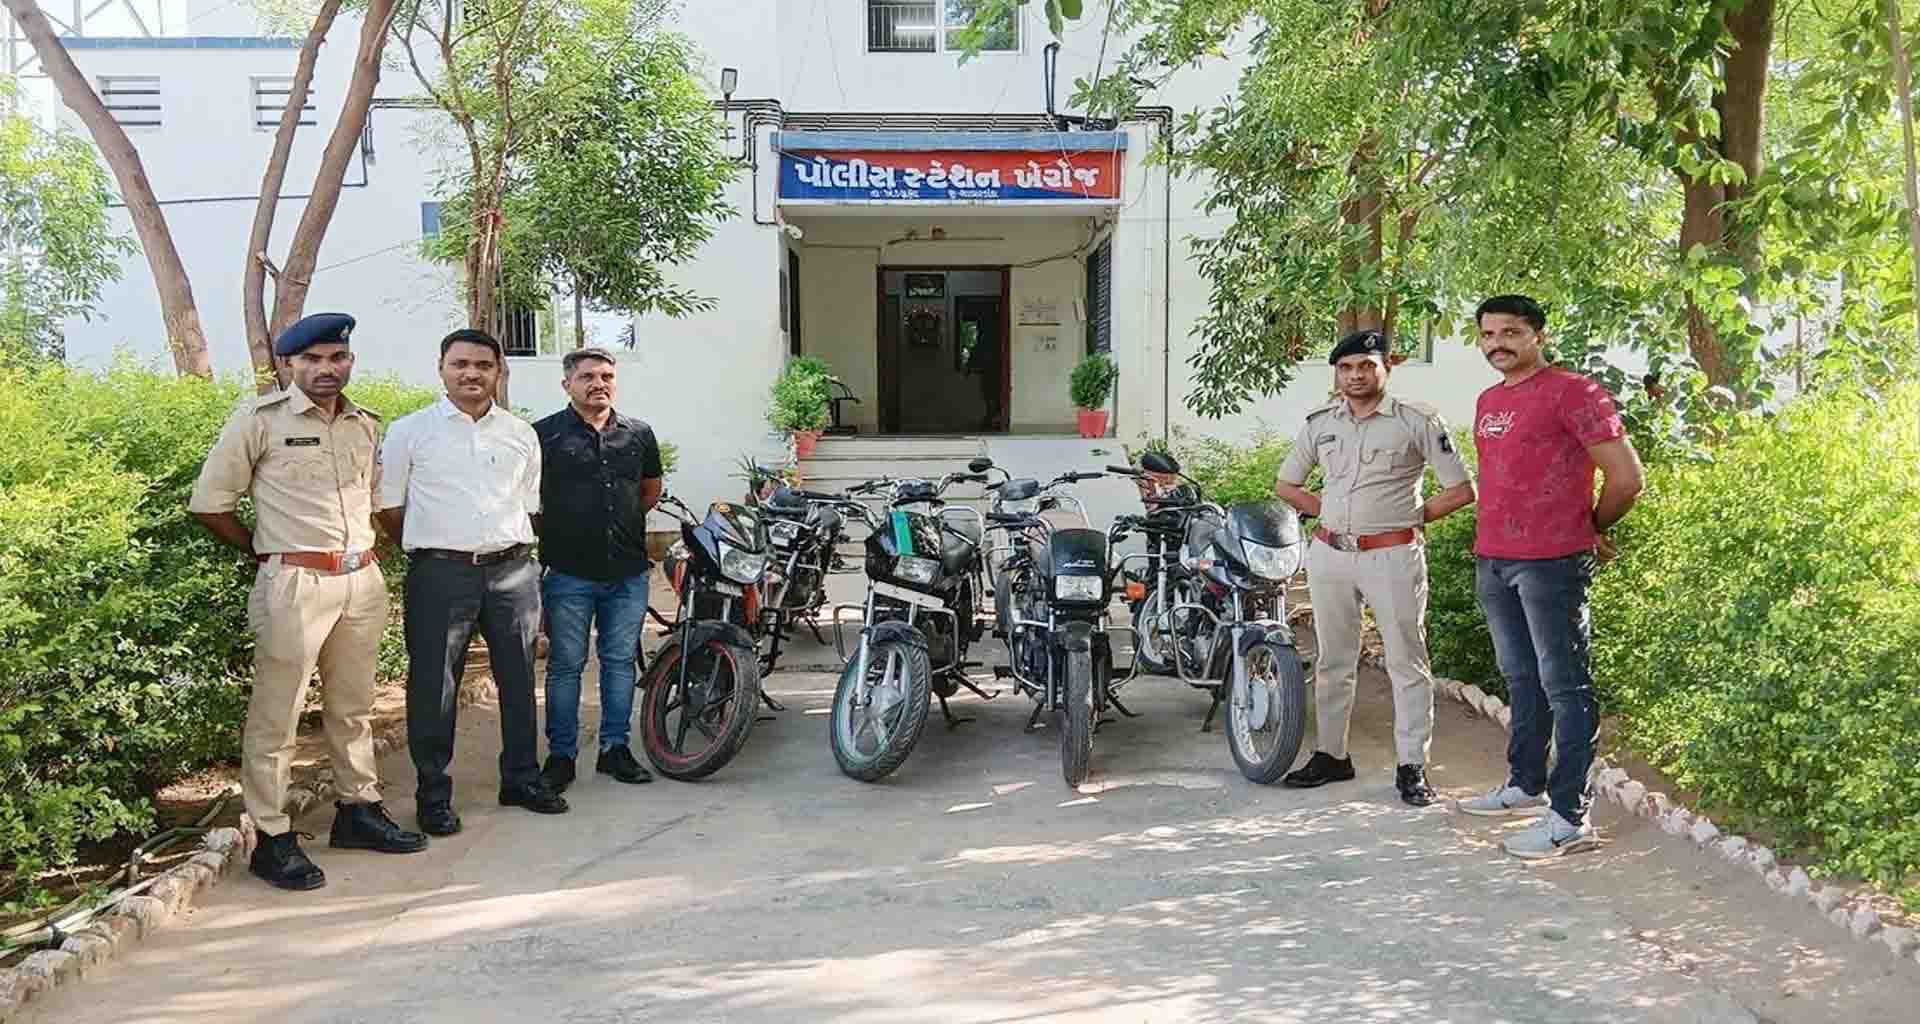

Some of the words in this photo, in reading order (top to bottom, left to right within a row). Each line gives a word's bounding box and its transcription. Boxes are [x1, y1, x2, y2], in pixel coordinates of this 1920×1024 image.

[795, 155, 896, 188] પોલીસ
[904, 160, 1000, 188] સ્ટેશન
[1014, 159, 1099, 187] ખેરોજ
